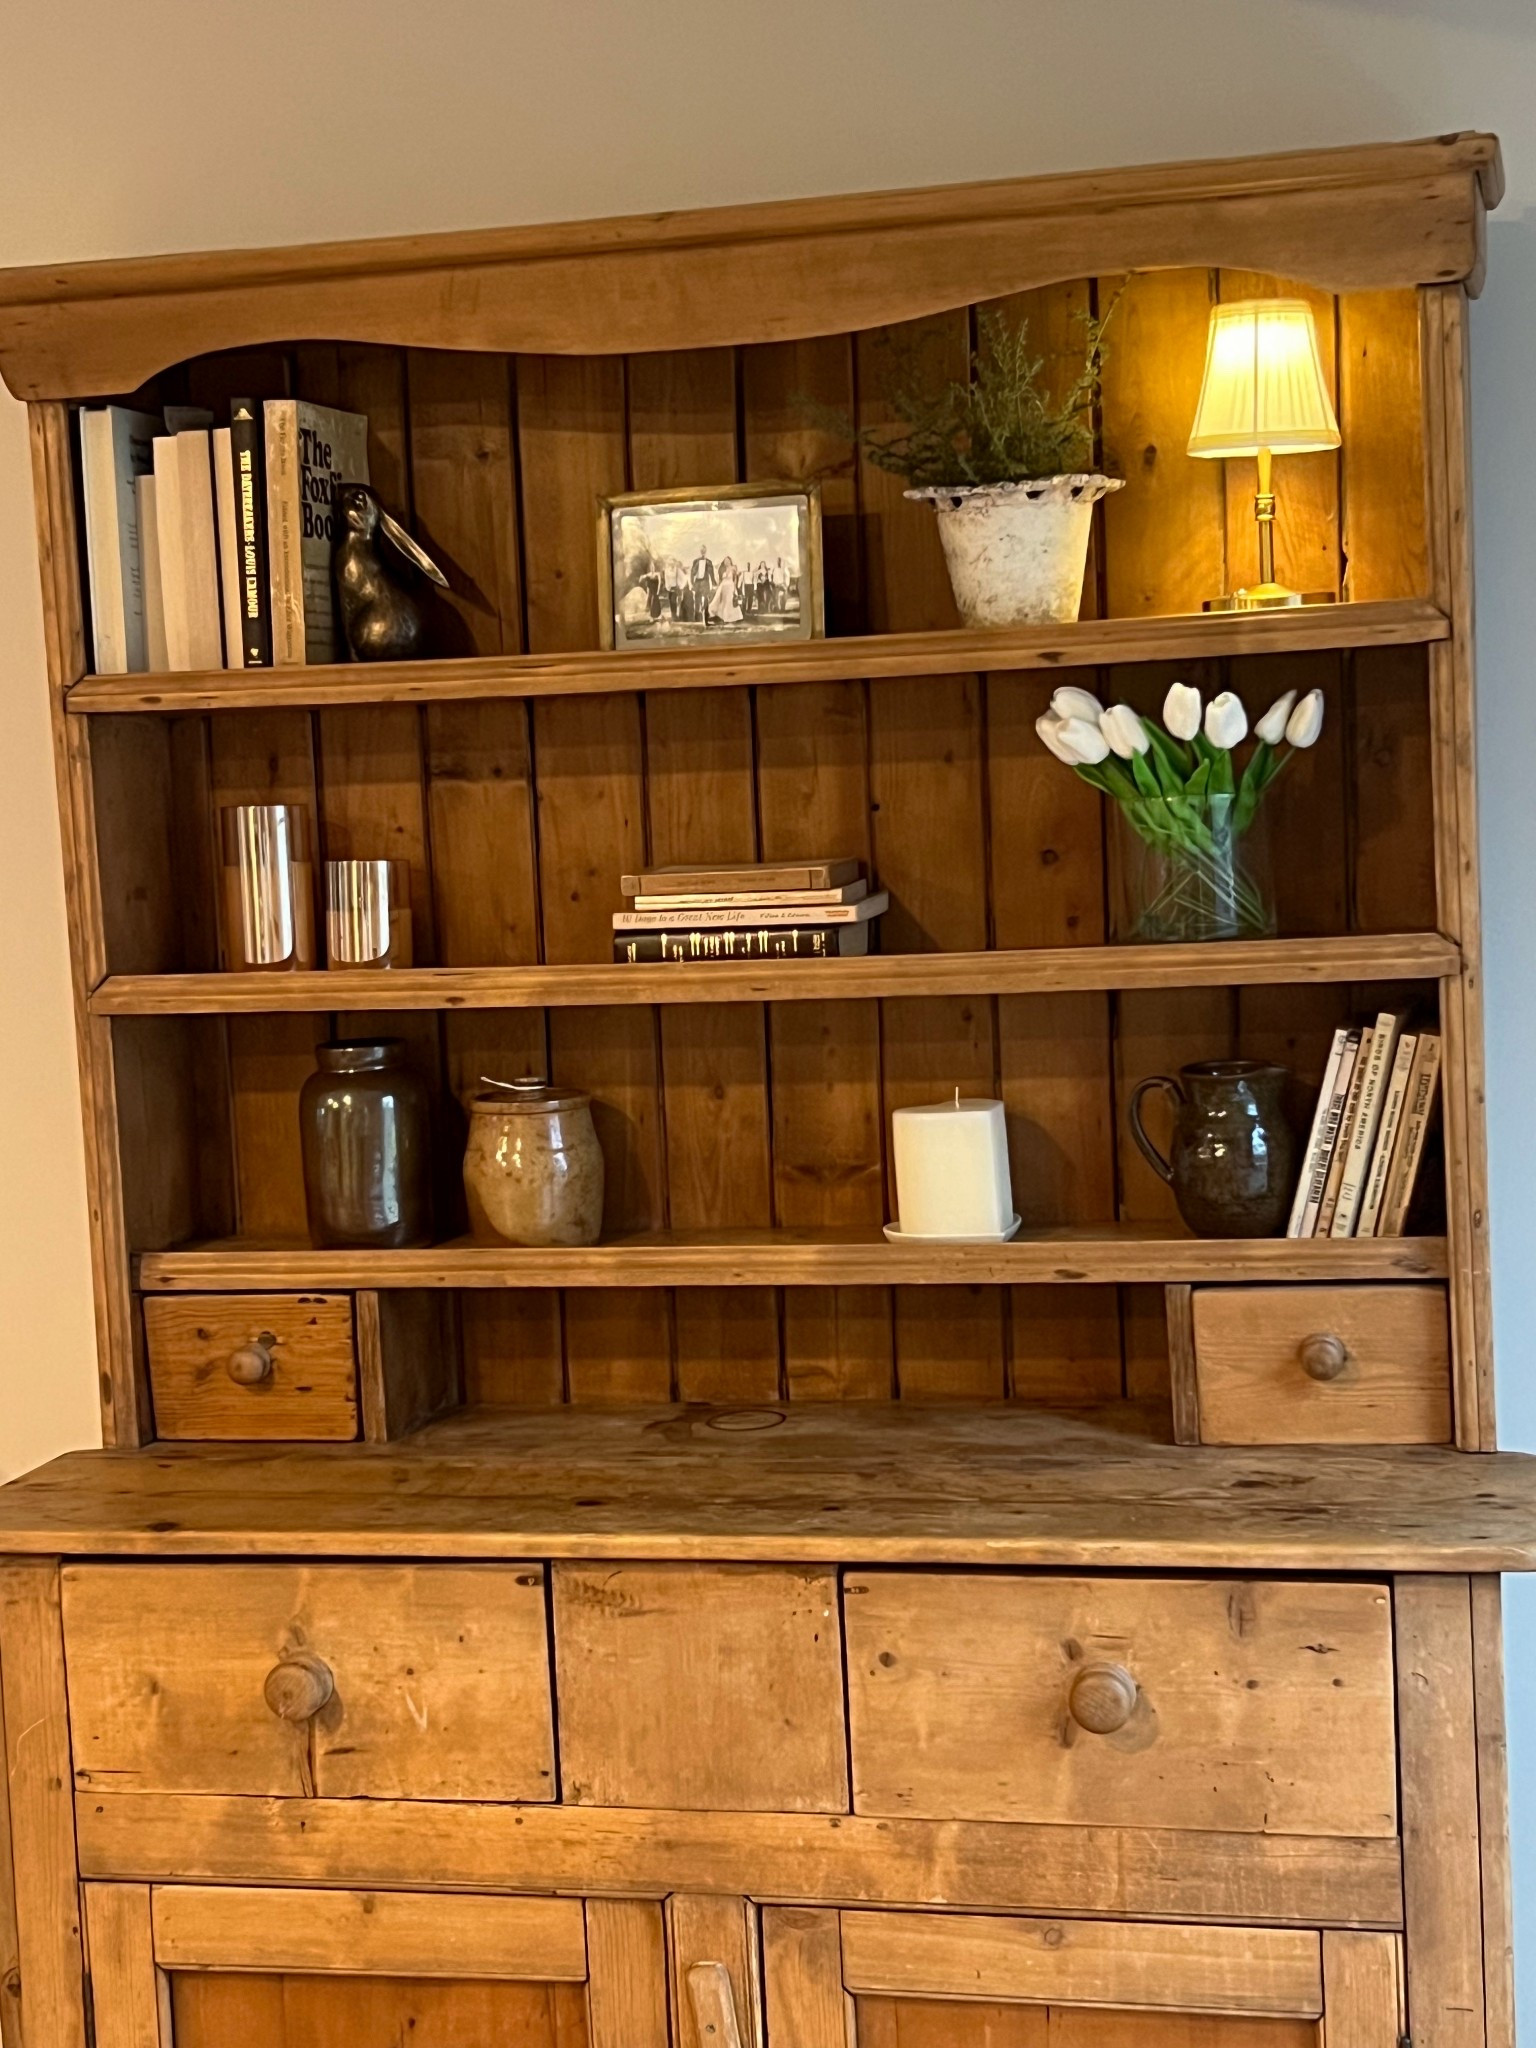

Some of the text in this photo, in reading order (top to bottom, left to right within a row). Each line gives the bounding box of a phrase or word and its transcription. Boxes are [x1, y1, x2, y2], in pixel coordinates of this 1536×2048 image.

[240, 450, 252, 472] THE
[299, 427, 331, 469] The
[301, 464, 342, 505] Foxf
[301, 501, 333, 541] Boo
[244, 545, 257, 575] LOUIS
[677, 912, 703, 922] Great
[704, 912, 725, 921] New
[726, 911, 745, 921] Life
[1354, 1033, 1386, 1150] BIRDS OF NORTH AMERICA
